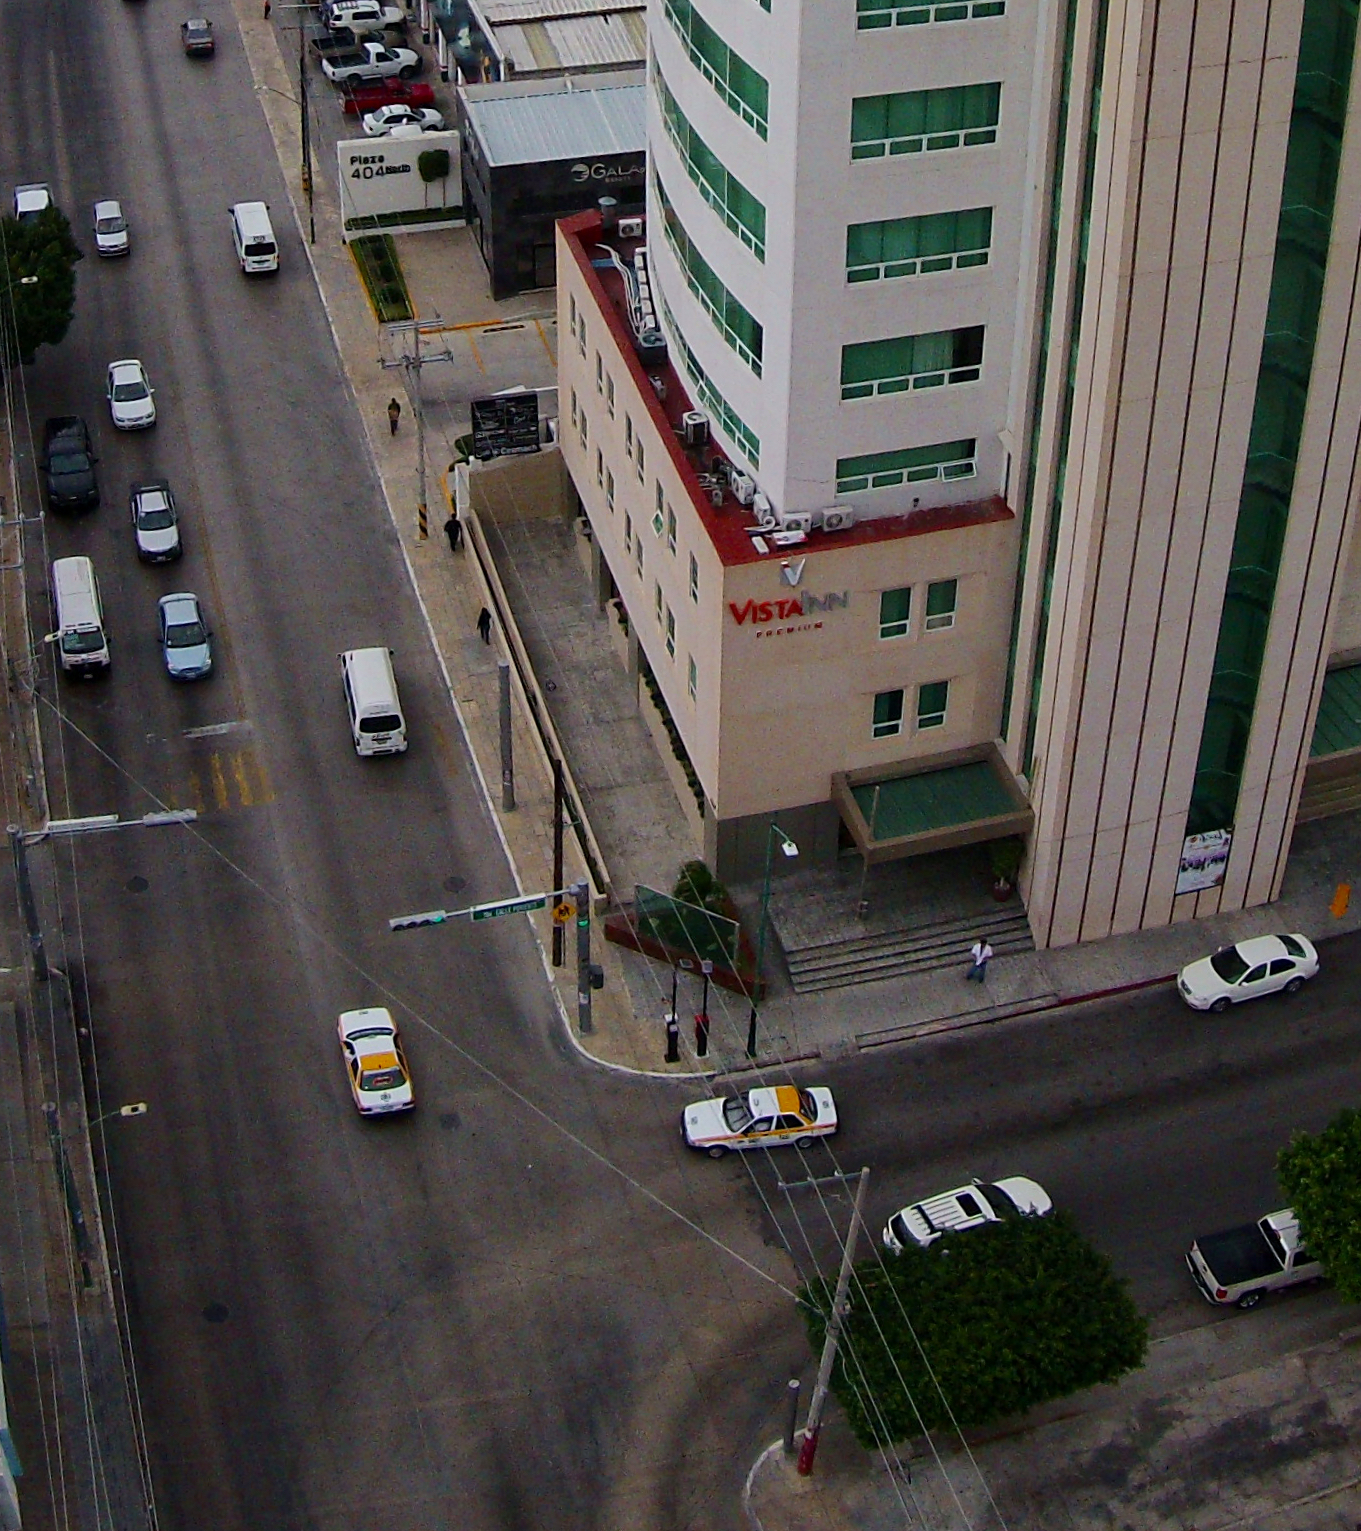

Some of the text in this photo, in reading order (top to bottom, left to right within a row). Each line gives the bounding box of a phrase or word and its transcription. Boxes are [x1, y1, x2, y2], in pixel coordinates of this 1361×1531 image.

[350, 155, 385, 165] Plaza
[351, 166, 384, 179] 404
[756, 621, 823, 639] PREMIUM
